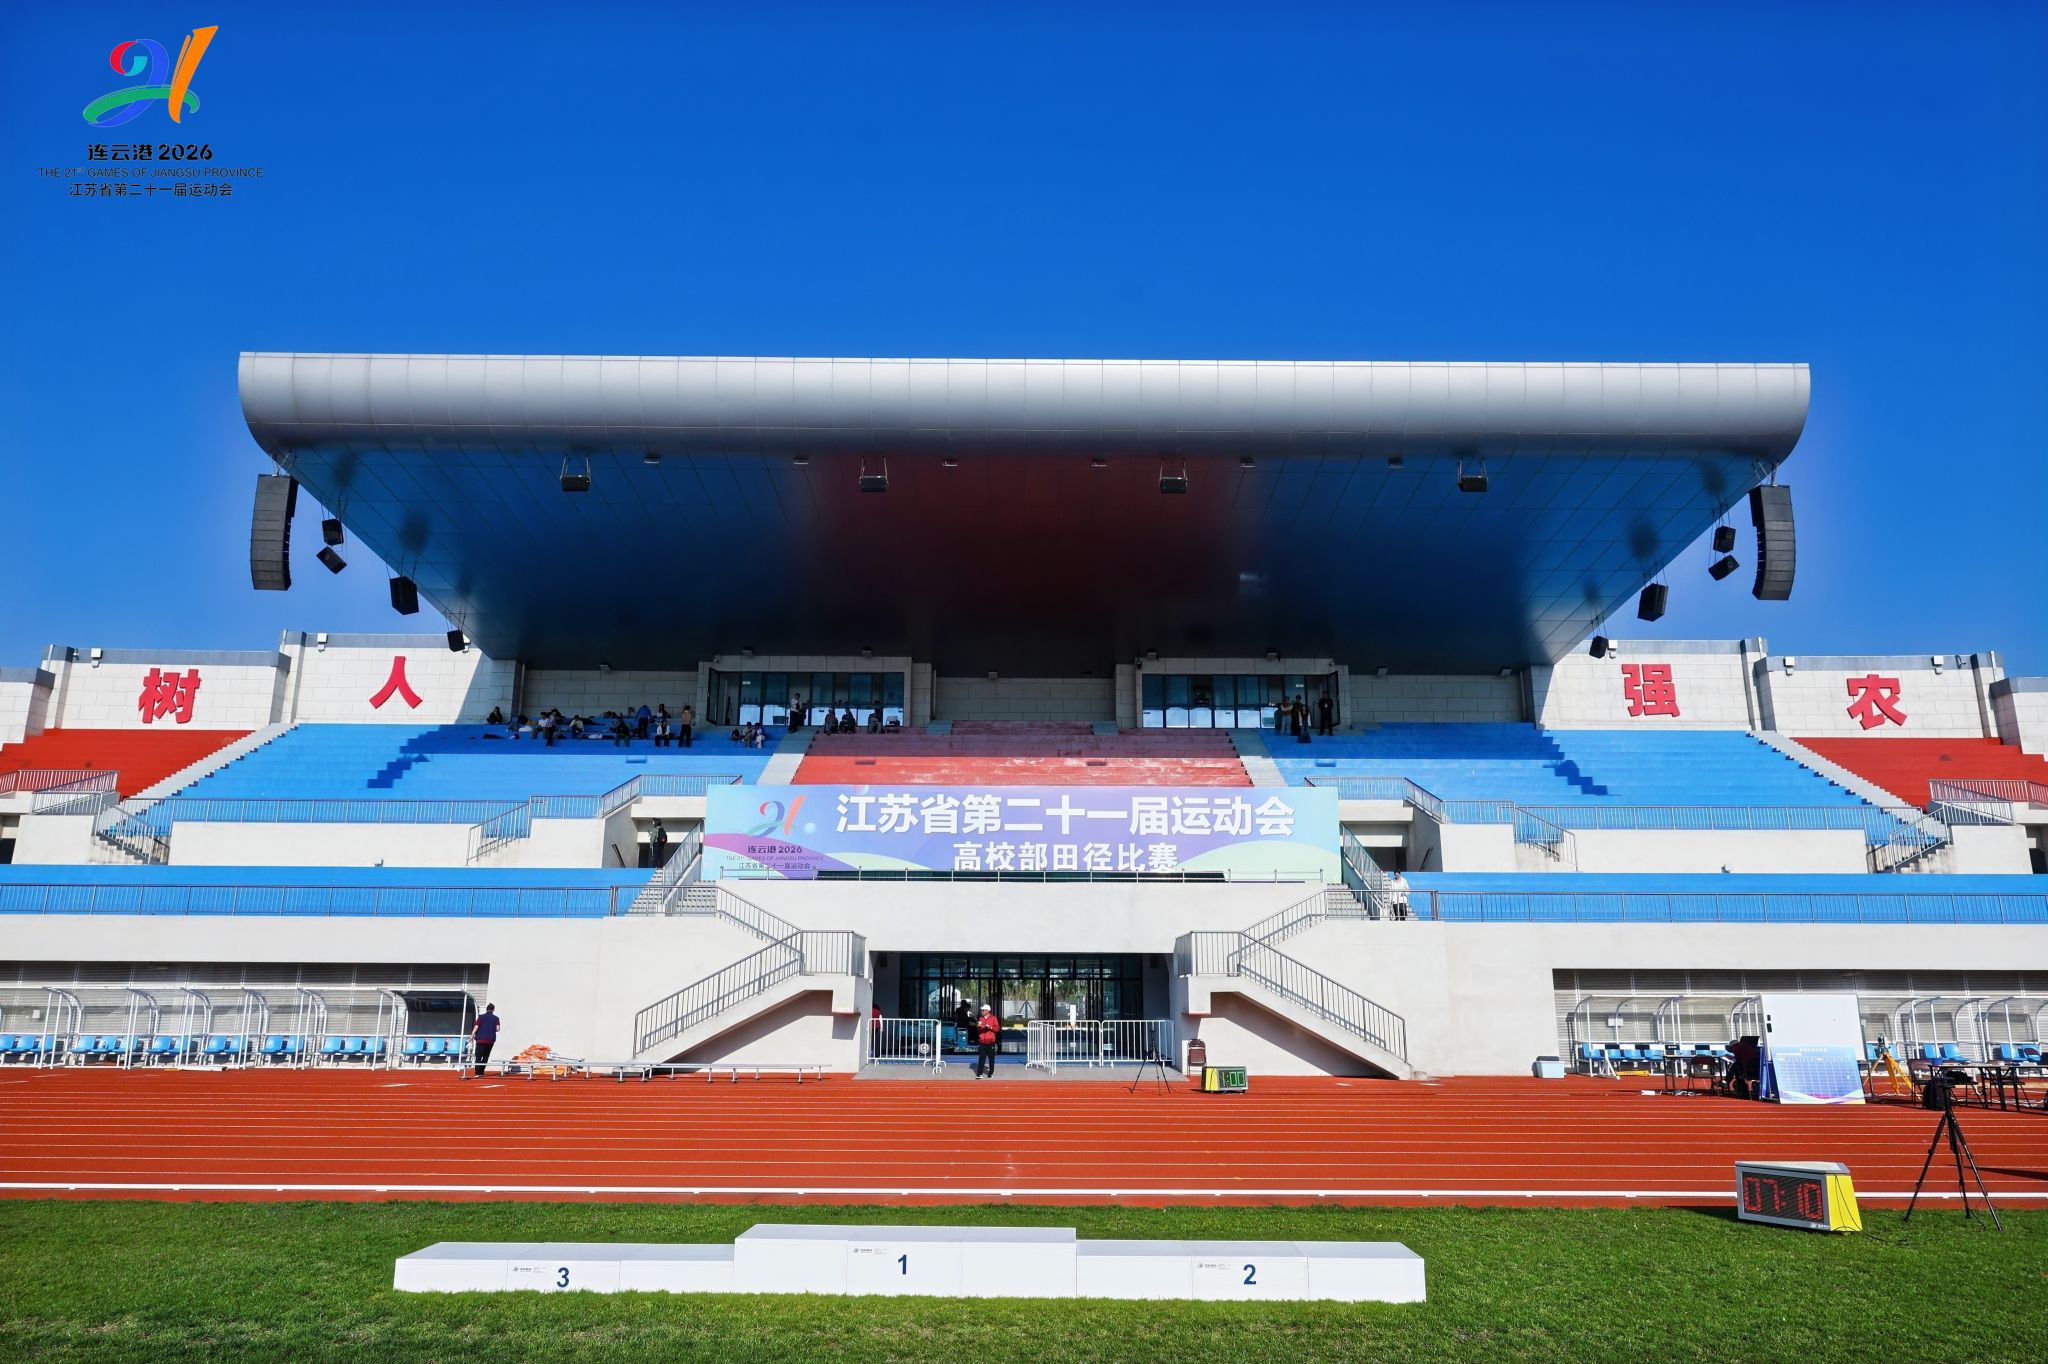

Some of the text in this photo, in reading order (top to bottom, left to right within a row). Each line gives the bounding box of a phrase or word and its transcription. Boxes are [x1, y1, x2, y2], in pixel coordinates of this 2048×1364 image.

[139, 668, 201, 724] 树
[369, 656, 423, 709] 人
[1621, 664, 1681, 717] 强
[1846, 674, 1907, 730] 农
[836, 793, 1296, 837] 江苏省第二十一届运动会
[778, 845, 803, 854] 2026
[953, 841, 1179, 872] 高校部田径比赛
[556, 1267, 570, 1288] 3
[898, 1254, 907, 1275] 1
[1243, 1264, 1257, 1285] 2
